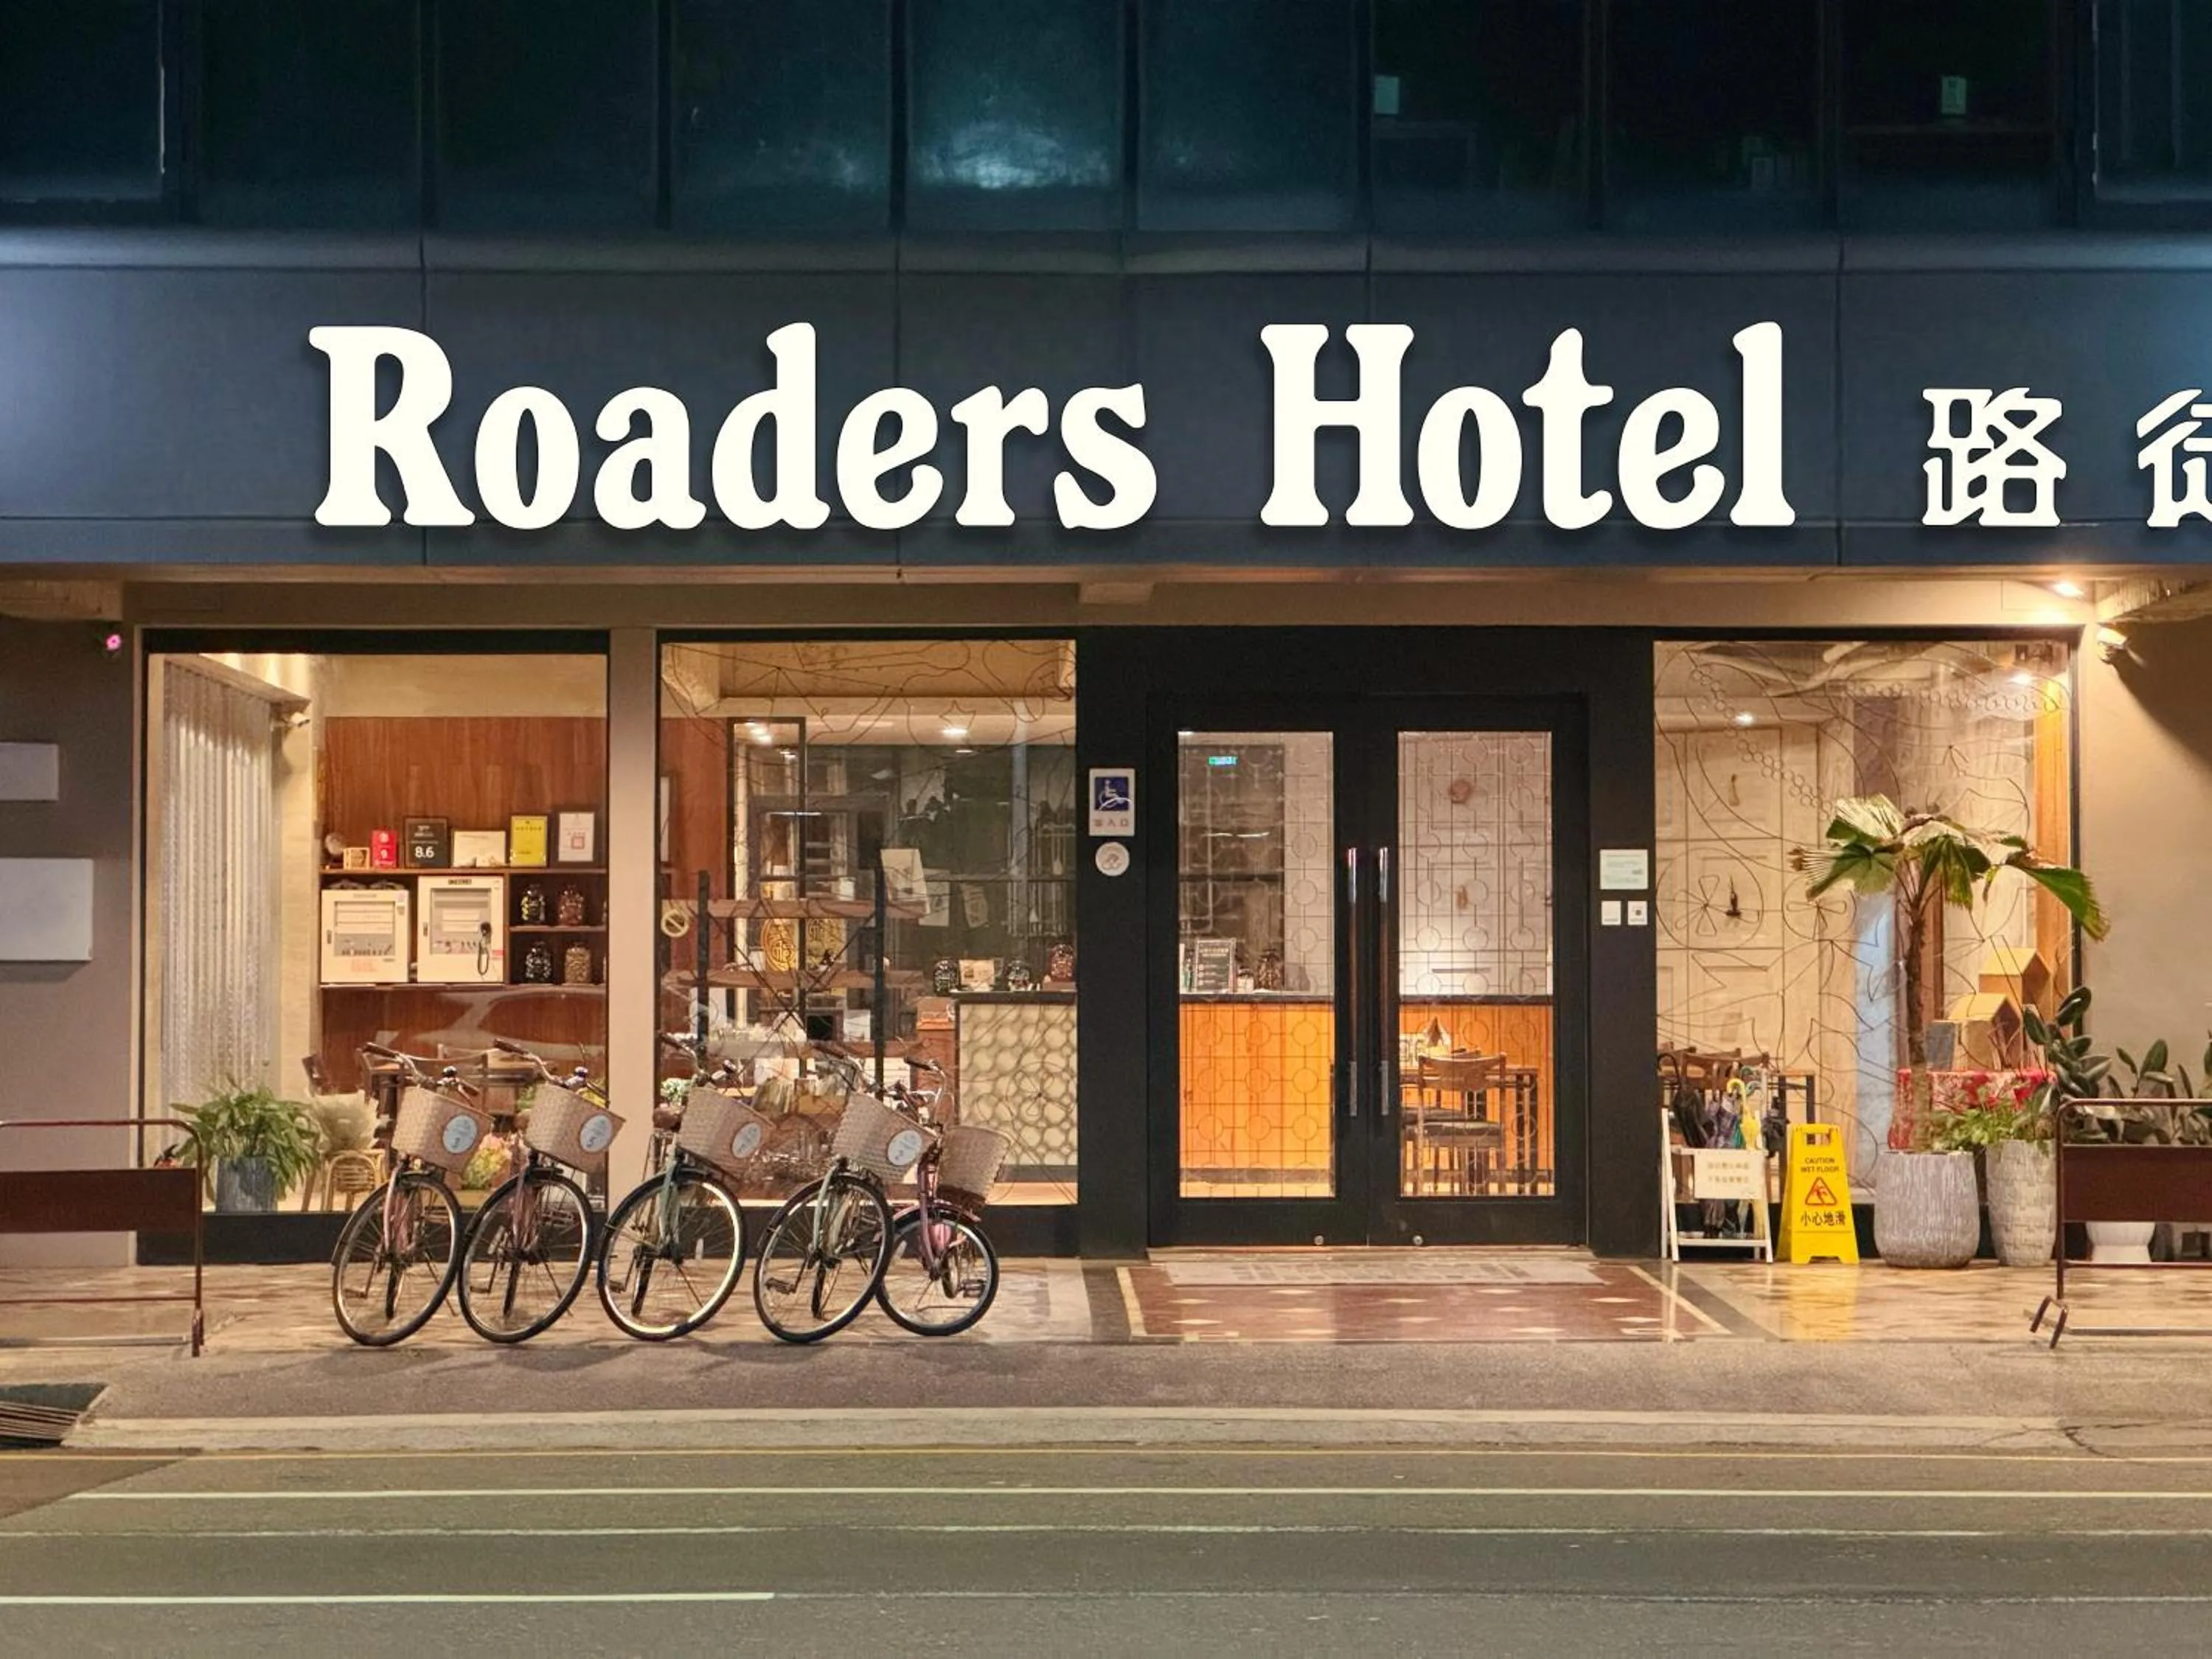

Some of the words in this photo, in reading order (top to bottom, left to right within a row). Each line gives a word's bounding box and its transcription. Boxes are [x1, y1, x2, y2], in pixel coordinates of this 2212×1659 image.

[309, 322, 1157, 530] Roaders
[1260, 321, 1796, 530] Hotel
[414, 846, 435, 858] 8.6
[1804, 1156, 1835, 1164] CAUTION
[1801, 1211, 1846, 1227] 小心地滑
